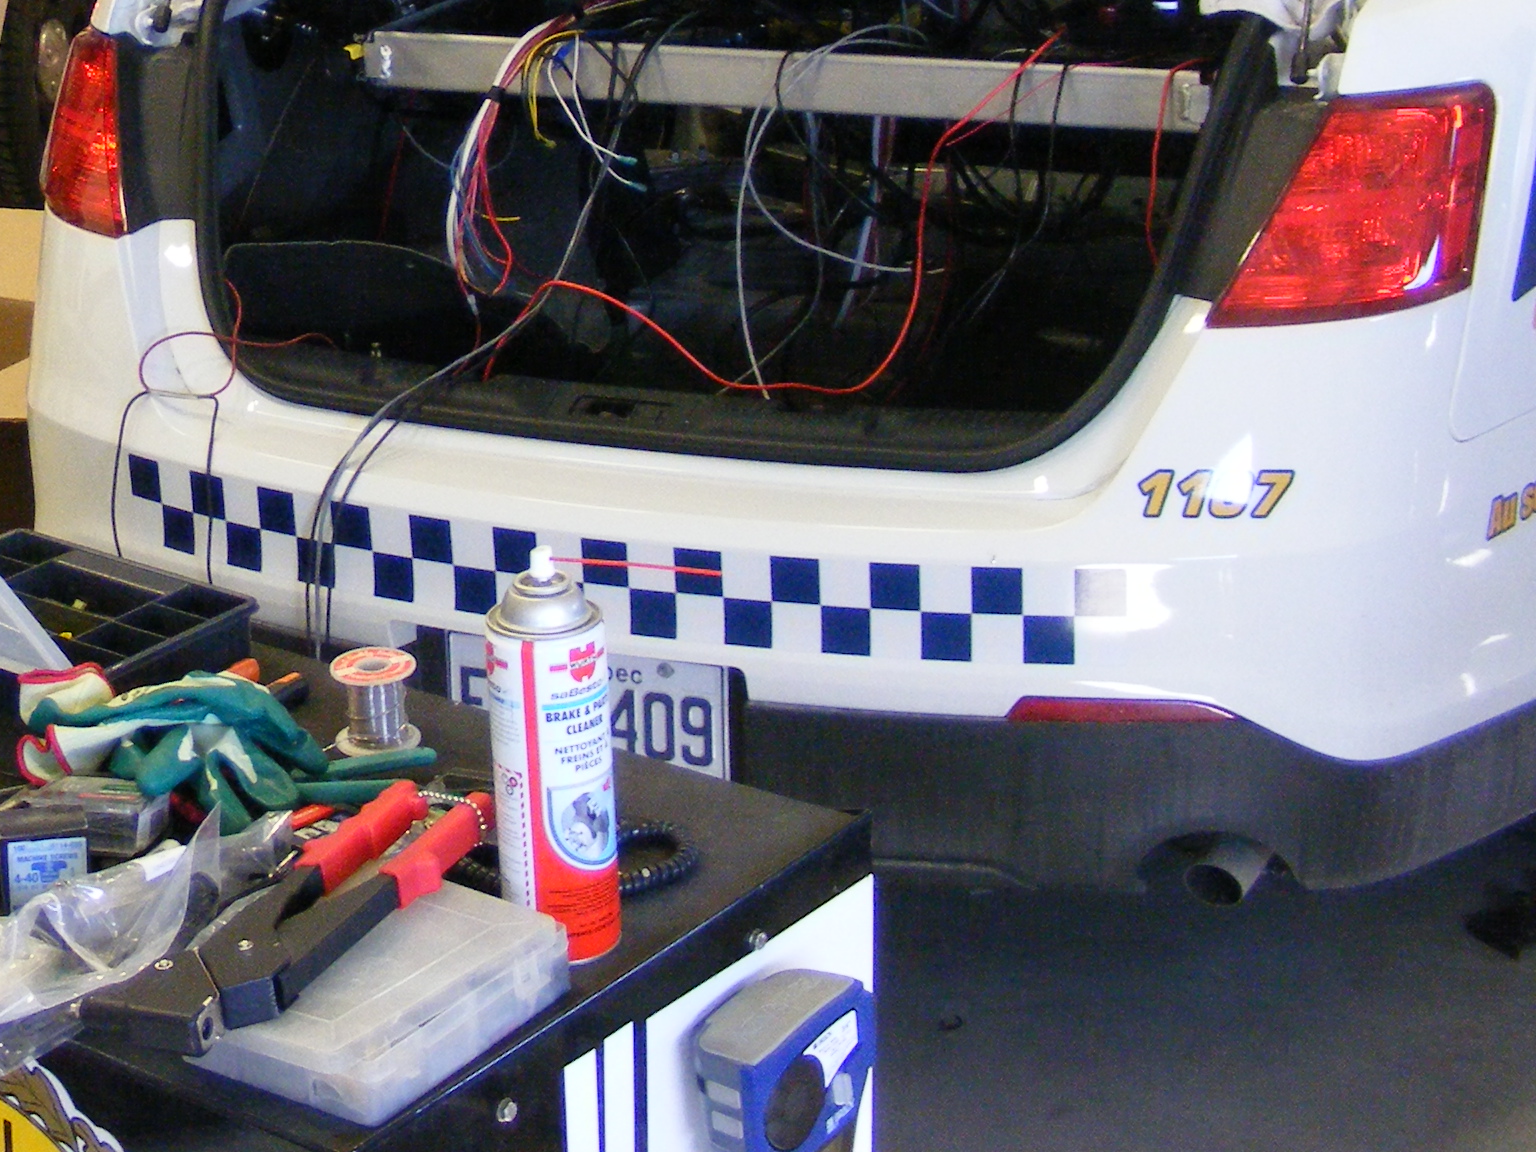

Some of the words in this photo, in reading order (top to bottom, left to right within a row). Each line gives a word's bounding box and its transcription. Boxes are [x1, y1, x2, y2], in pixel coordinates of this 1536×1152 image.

[545, 708, 581, 723] BRAKE
[566, 714, 603, 736] CLEANER
[561, 749, 594, 765] FREINS
